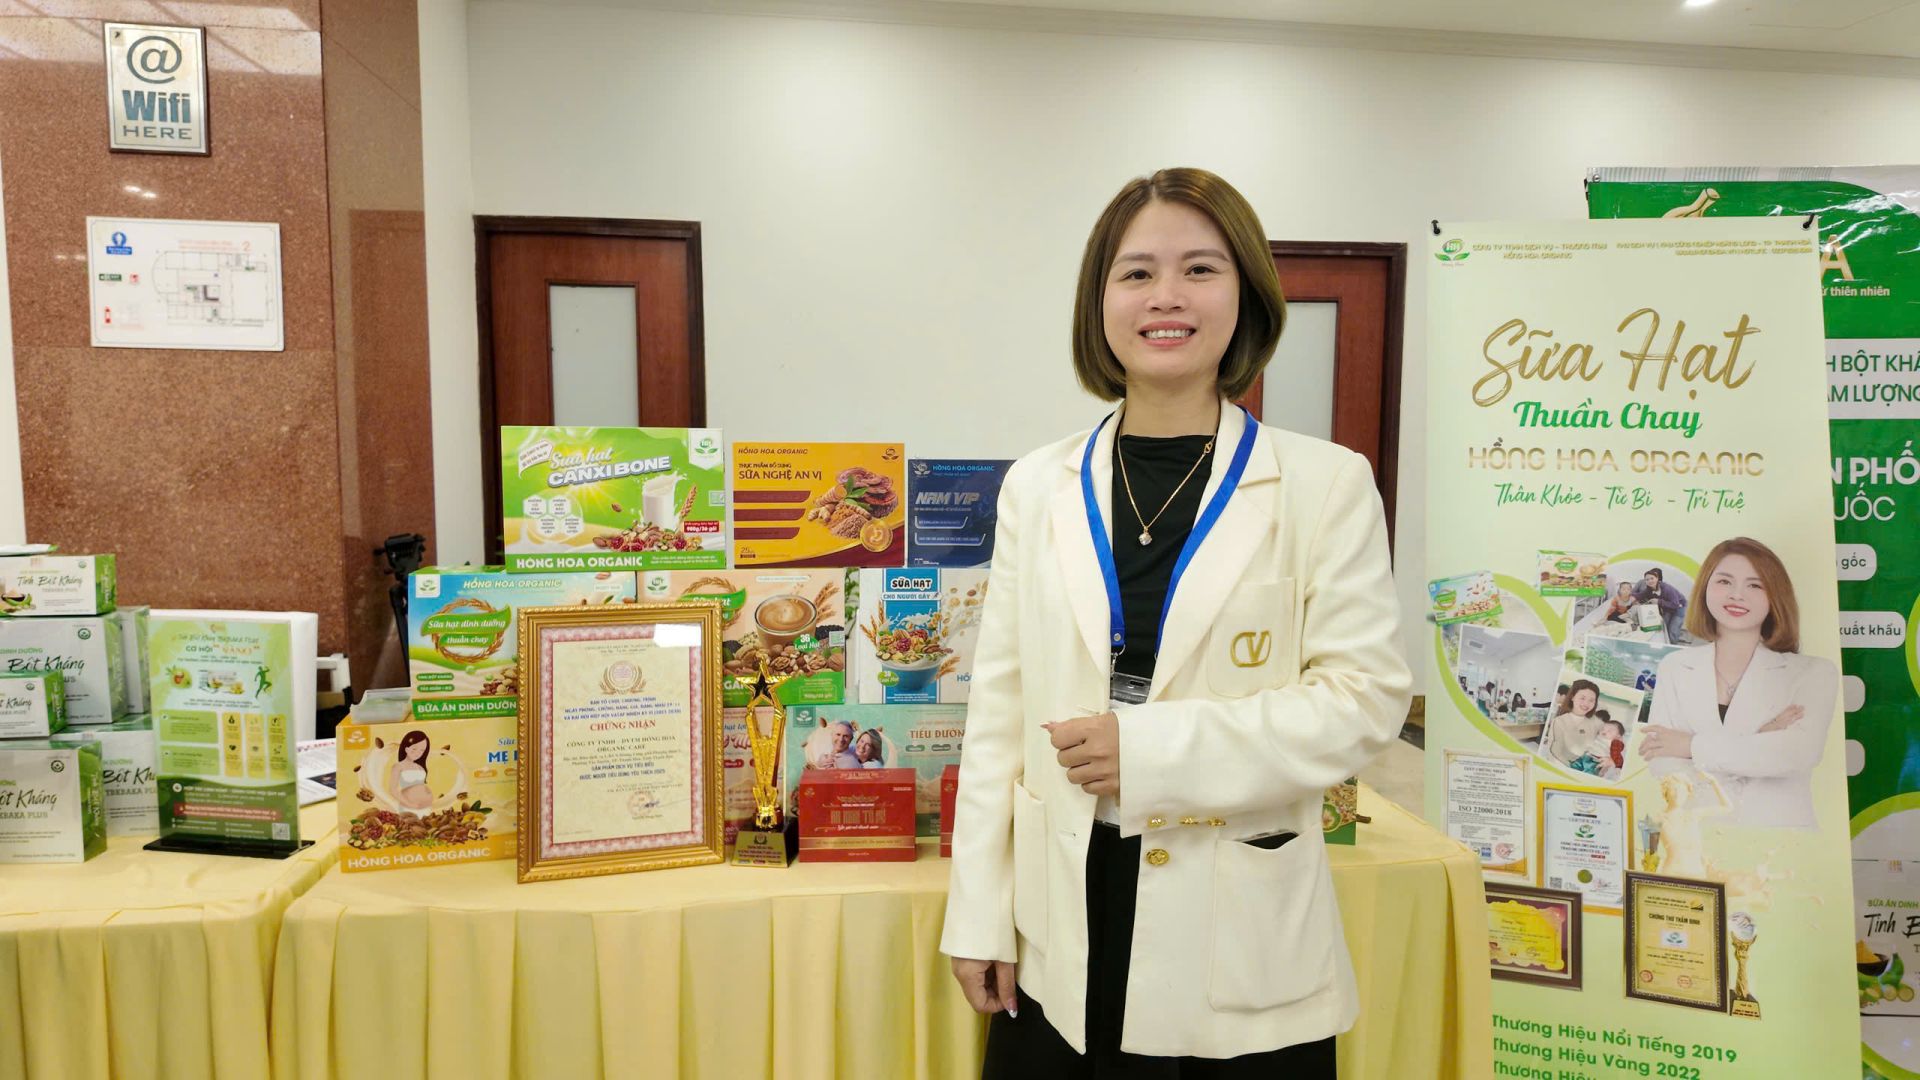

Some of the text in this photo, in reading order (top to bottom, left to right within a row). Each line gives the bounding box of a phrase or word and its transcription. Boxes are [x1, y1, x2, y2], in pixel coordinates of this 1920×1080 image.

[122, 89, 192, 124] Wifi
[122, 125, 193, 140] HERE
[1830, 286, 1890, 297] thiên nhiên
[1471, 308, 1761, 408] Sữa Hạt
[1840, 348, 1881, 377] BỘT
[1512, 397, 1703, 439] Thuần Chay
[737, 446, 759, 455] HỒNG
[1468, 437, 1765, 477] HỒNG HOA ORGANIC
[932, 463, 952, 472] HỒNG
[738, 469, 823, 481] SỮA NGHỆ AN VỊ
[953, 491, 979, 505] VIP
[1494, 482, 1537, 509] Thân
[1539, 484, 1583, 508] Khỏe
[1604, 486, 1628, 509] Từ
[1632, 487, 1653, 511] Bi
[1712, 489, 1745, 514] Tuệ
[517, 556, 556, 569] HỒNG
[557, 557, 585, 568] HOA
[588, 556, 643, 568] ORGANIC
[1841, 552, 1866, 571] gốc
[463, 577, 563, 590] HỒNG HOA ORGANIC
[892, 578, 932, 590] SỮA HẠT
[897, 592, 917, 600] NGƯỜI
[459, 618, 479, 628] dinh
[467, 635, 489, 645] chay
[7, 655, 85, 676] Bột Kháng
[957, 671, 971, 682] HỒ
[418, 699, 517, 713] BỮA ĂN DINH DƯỠN
[590, 719, 657, 732] CHỨNG NHẬN
[935, 728, 965, 738] ĐƯỜN
[488, 750, 509, 764] MẸ
[16, 788, 58, 812] Kháng
[1458, 805, 1513, 817] ISO 22000:2018
[347, 847, 491, 870] HỒNG HOA ORGANIC
[1492, 1014, 1738, 1064] Thương Hiệu Nổi Tiếng 2019
[1493, 1037, 1701, 1080] Thương Hiệu Vàng 2022
